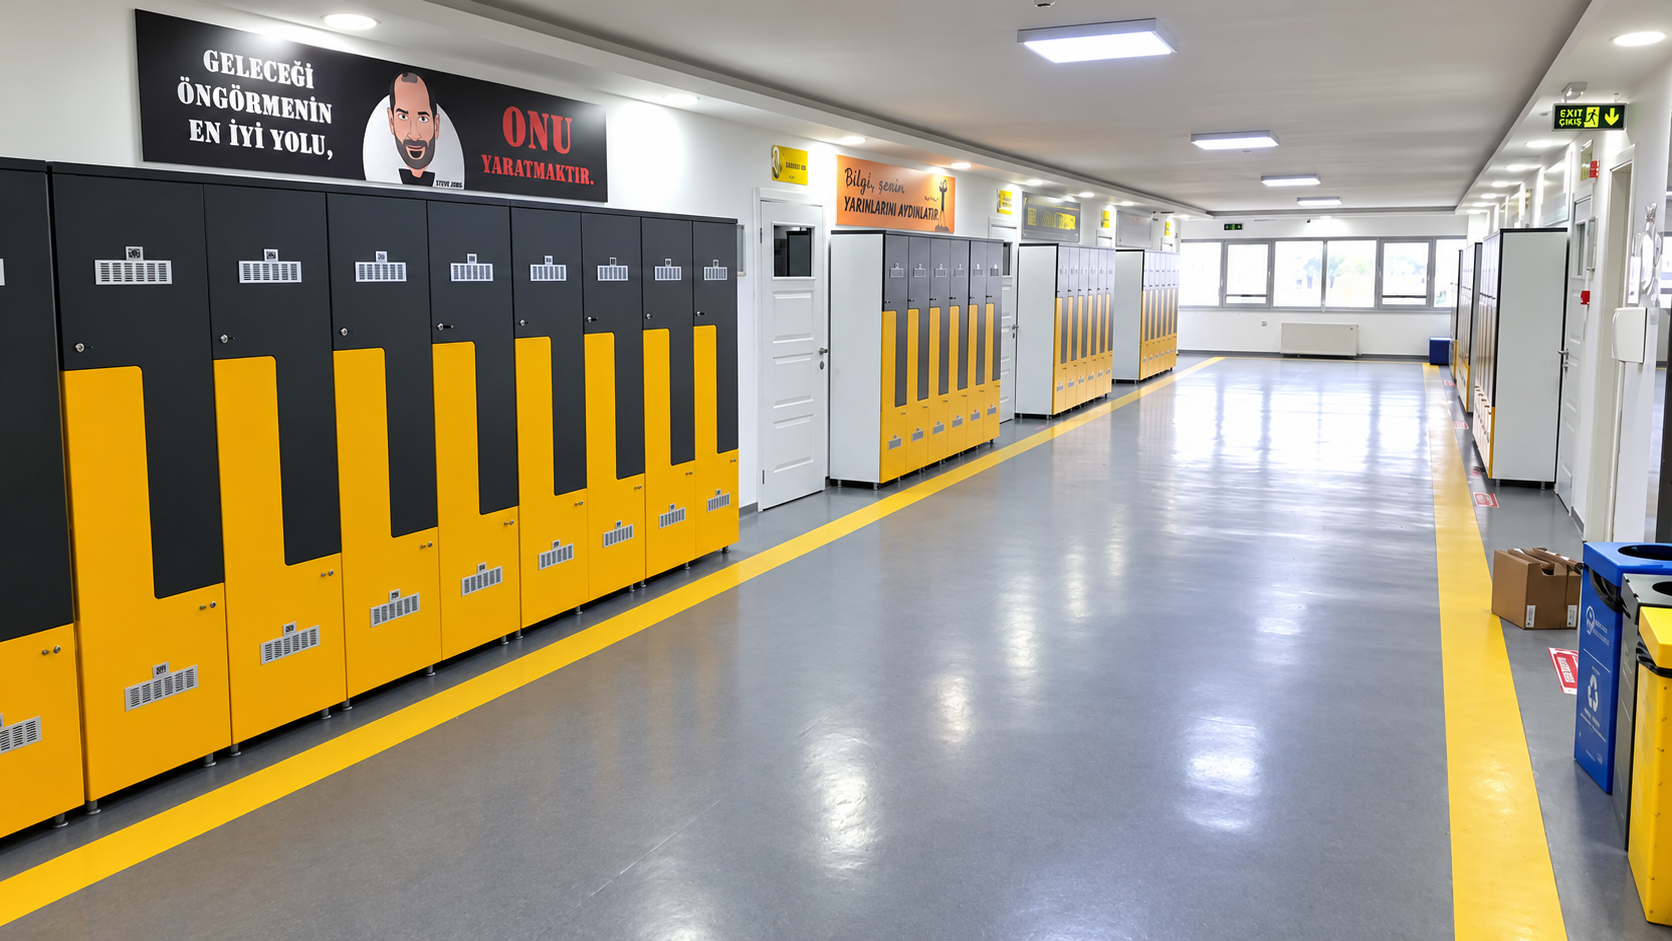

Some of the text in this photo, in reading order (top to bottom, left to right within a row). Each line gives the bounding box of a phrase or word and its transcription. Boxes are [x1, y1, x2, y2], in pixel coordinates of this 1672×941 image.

[203, 50, 315, 89] GELECEĞİ
[177, 76, 333, 124] ÖNGÖRMENİN
[1560, 109, 1583, 118] EXIT
[188, 118, 334, 161] EN İYİ YOLU,
[502, 106, 573, 154] ONU
[1558, 118, 1582, 128] ÇIKIŞ
[480, 154, 595, 186] YARATMAKTIR.
[844, 195, 897, 217] YARINLARINI
